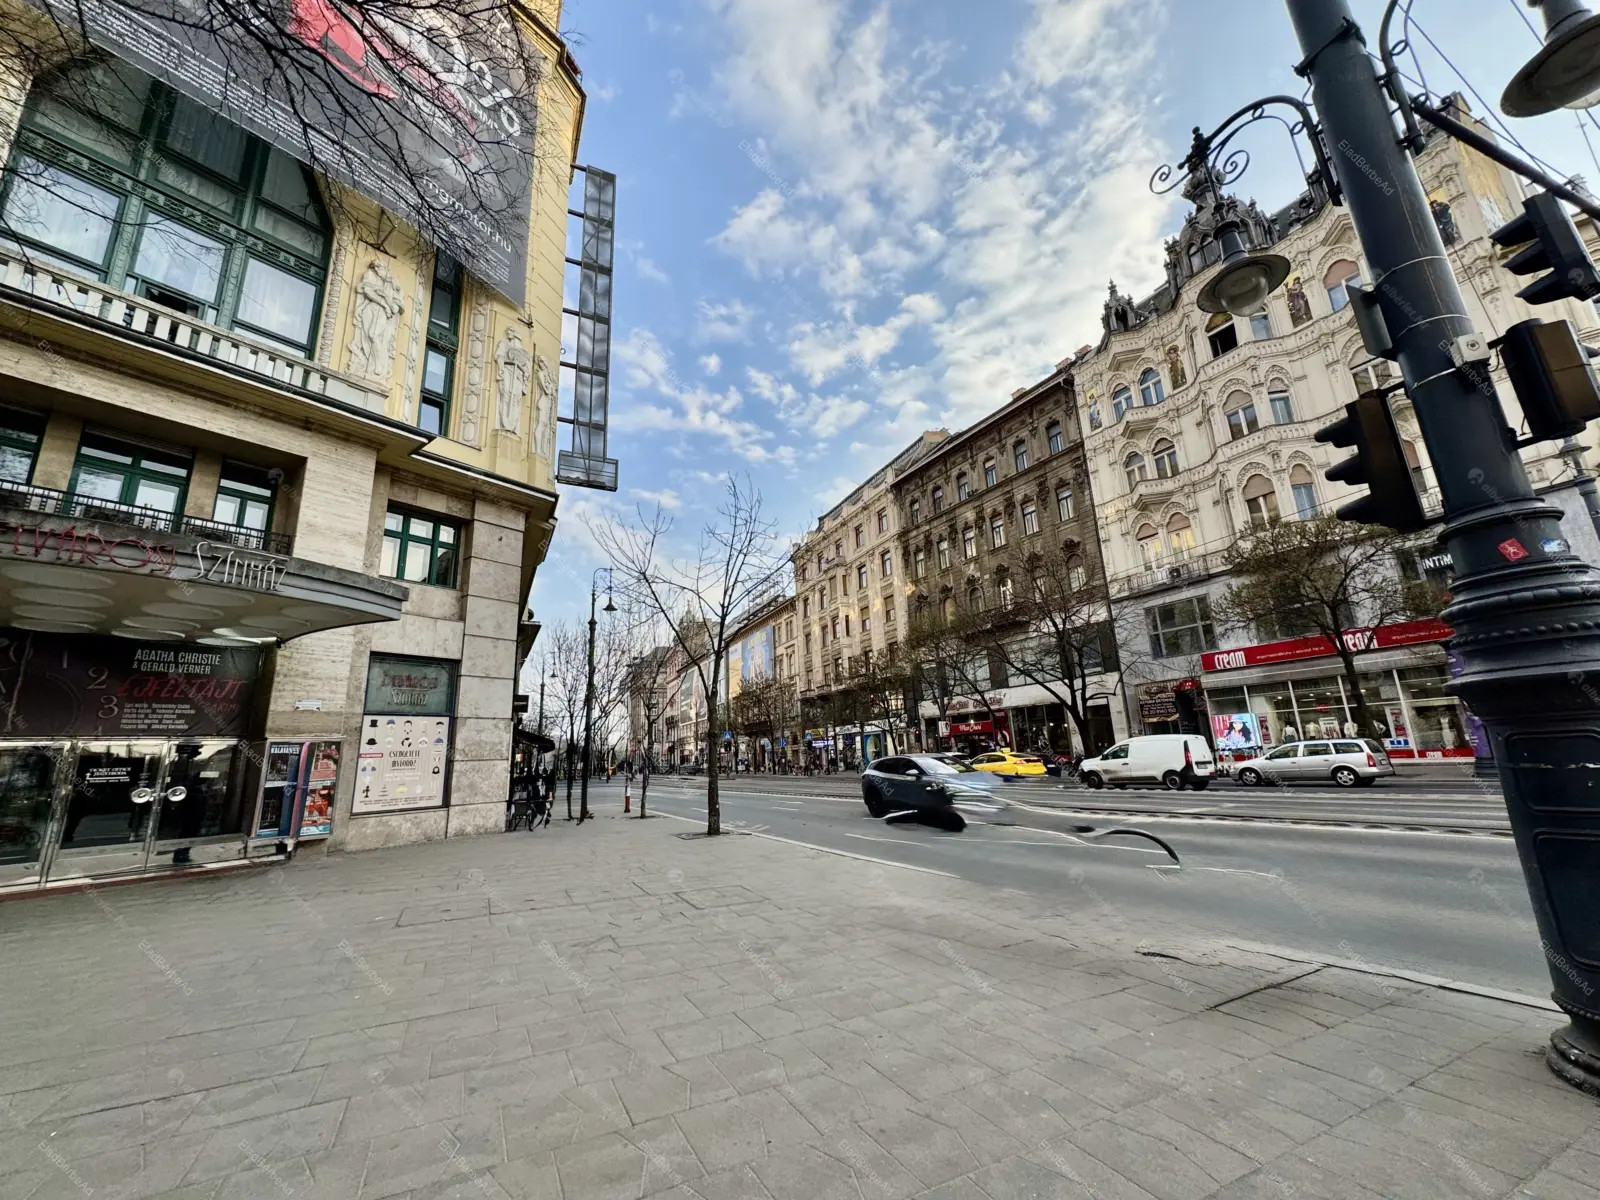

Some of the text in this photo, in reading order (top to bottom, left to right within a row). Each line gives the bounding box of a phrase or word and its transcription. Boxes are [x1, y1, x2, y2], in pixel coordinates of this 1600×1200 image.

[134, 649, 222, 665] AGATHA CHRISTIE
[1214, 650, 1246, 670] cream
[85, 666, 109, 690] 2
[140, 661, 175, 673] GERALD
[178, 663, 211, 675] VERNER
[98, 695, 118, 719] 3
